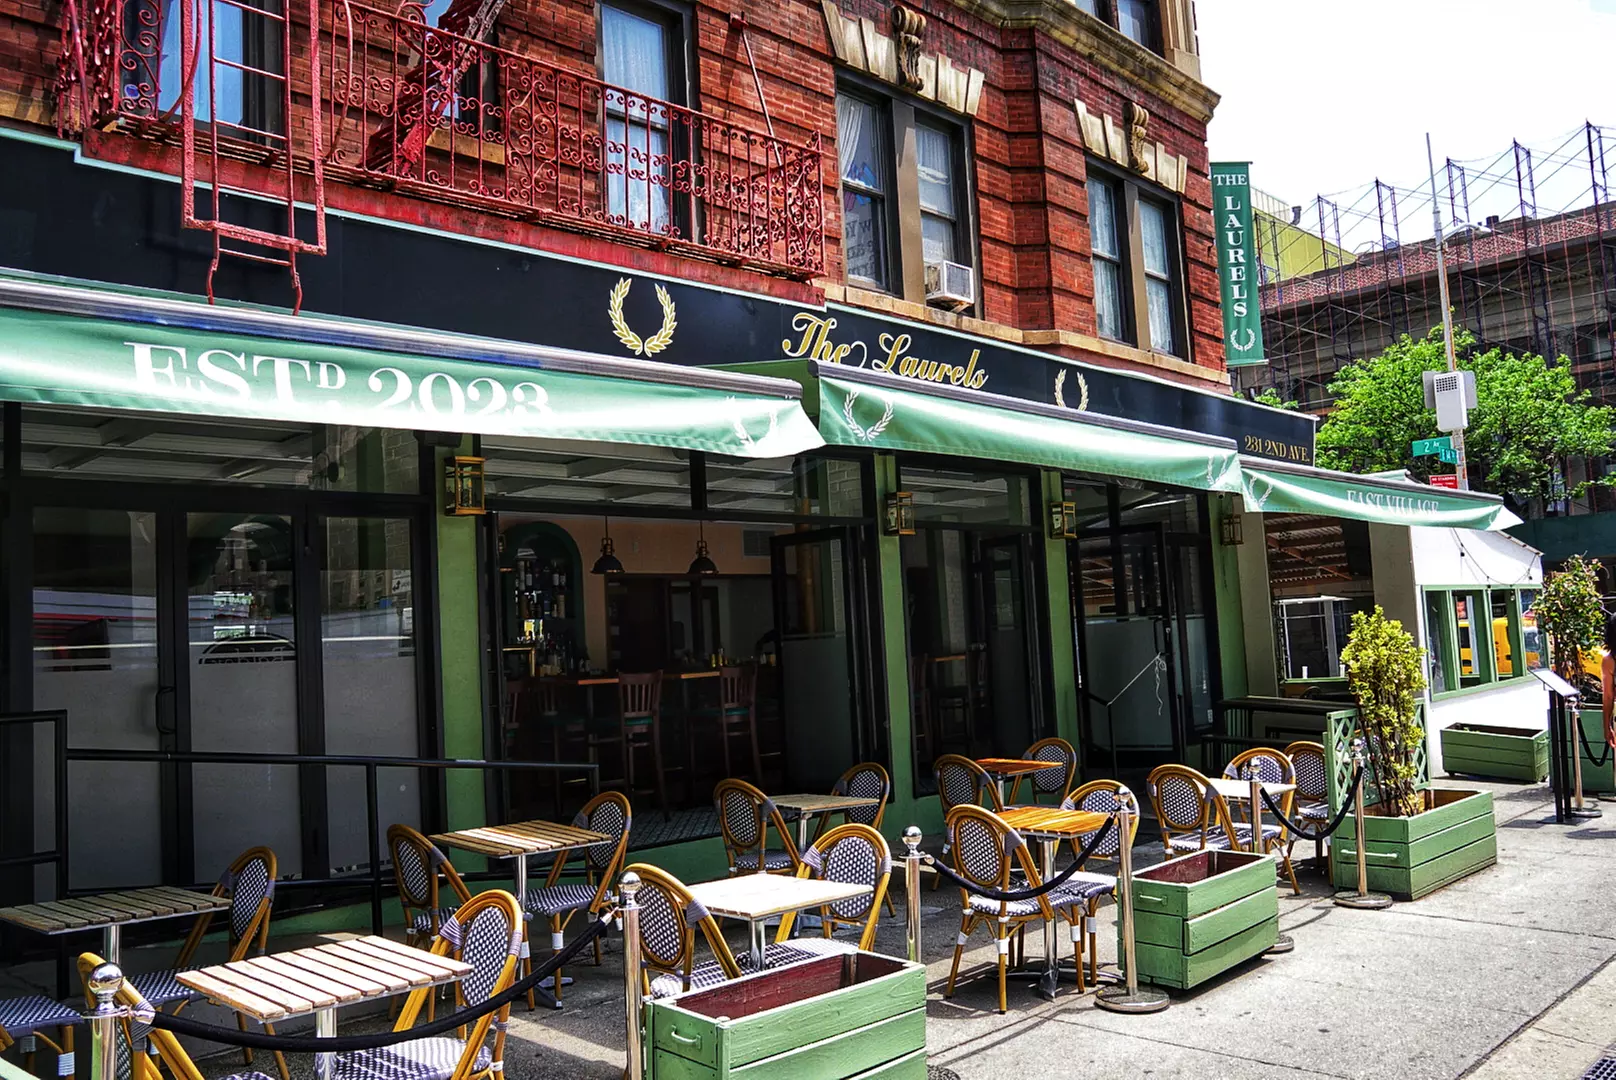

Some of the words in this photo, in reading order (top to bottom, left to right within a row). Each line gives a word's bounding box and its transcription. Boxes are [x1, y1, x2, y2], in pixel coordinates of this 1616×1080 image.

[1213, 174, 1247, 186] THE
[1224, 195, 1248, 318] LAURELS
[782, 311, 867, 368] The
[872, 332, 989, 389] Laurels
[367, 366, 551, 421] 2023
[1244, 435, 1263, 453] 231
[1265, 439, 1287, 458] 2ND
[1424, 441, 1430, 453] 2
[1347, 490, 1382, 512] EAST
[1383, 495, 1440, 515] VILLAGE
